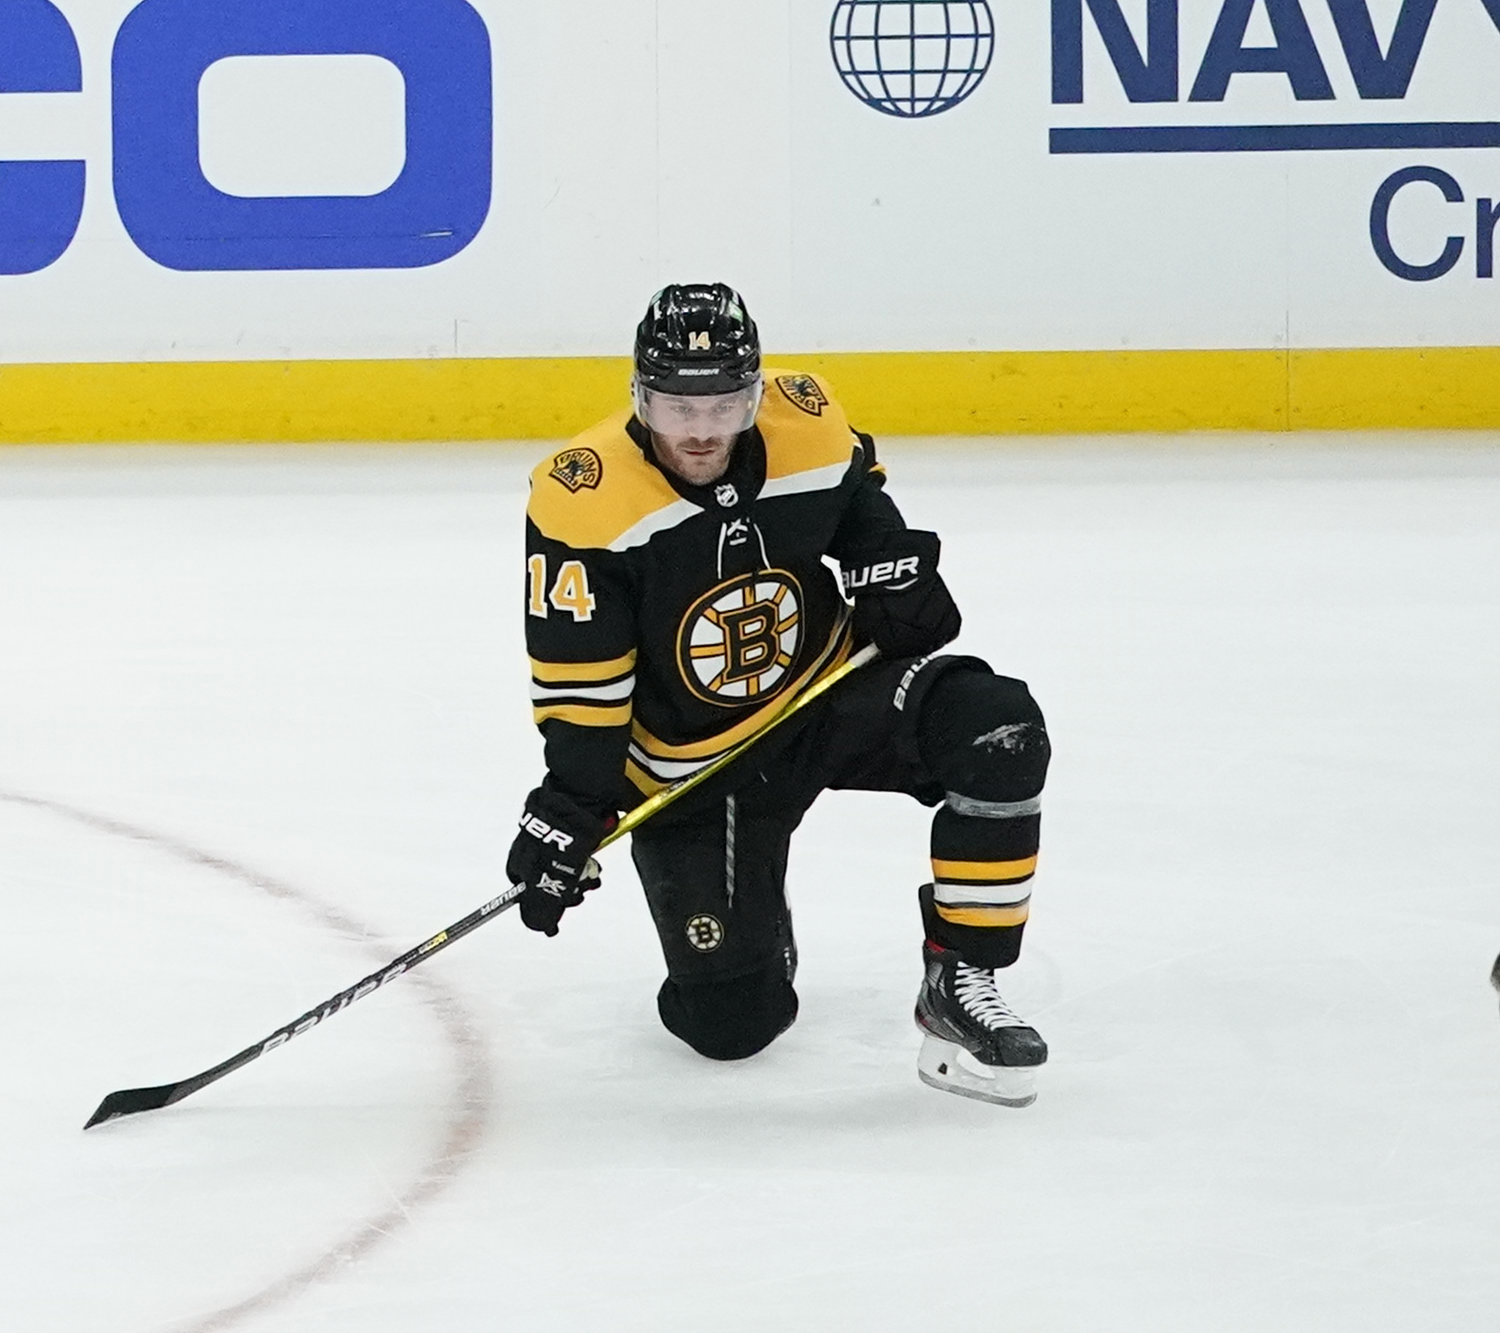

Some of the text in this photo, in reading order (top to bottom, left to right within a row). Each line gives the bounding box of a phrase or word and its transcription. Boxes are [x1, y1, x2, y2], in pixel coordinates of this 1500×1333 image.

[688, 332, 711, 350] 14
[678, 366, 720, 377] BAUER
[526, 553, 595, 623] 14
[721, 610, 777, 677] B
[891, 652, 937, 711] BAU
[519, 809, 574, 852] UER
